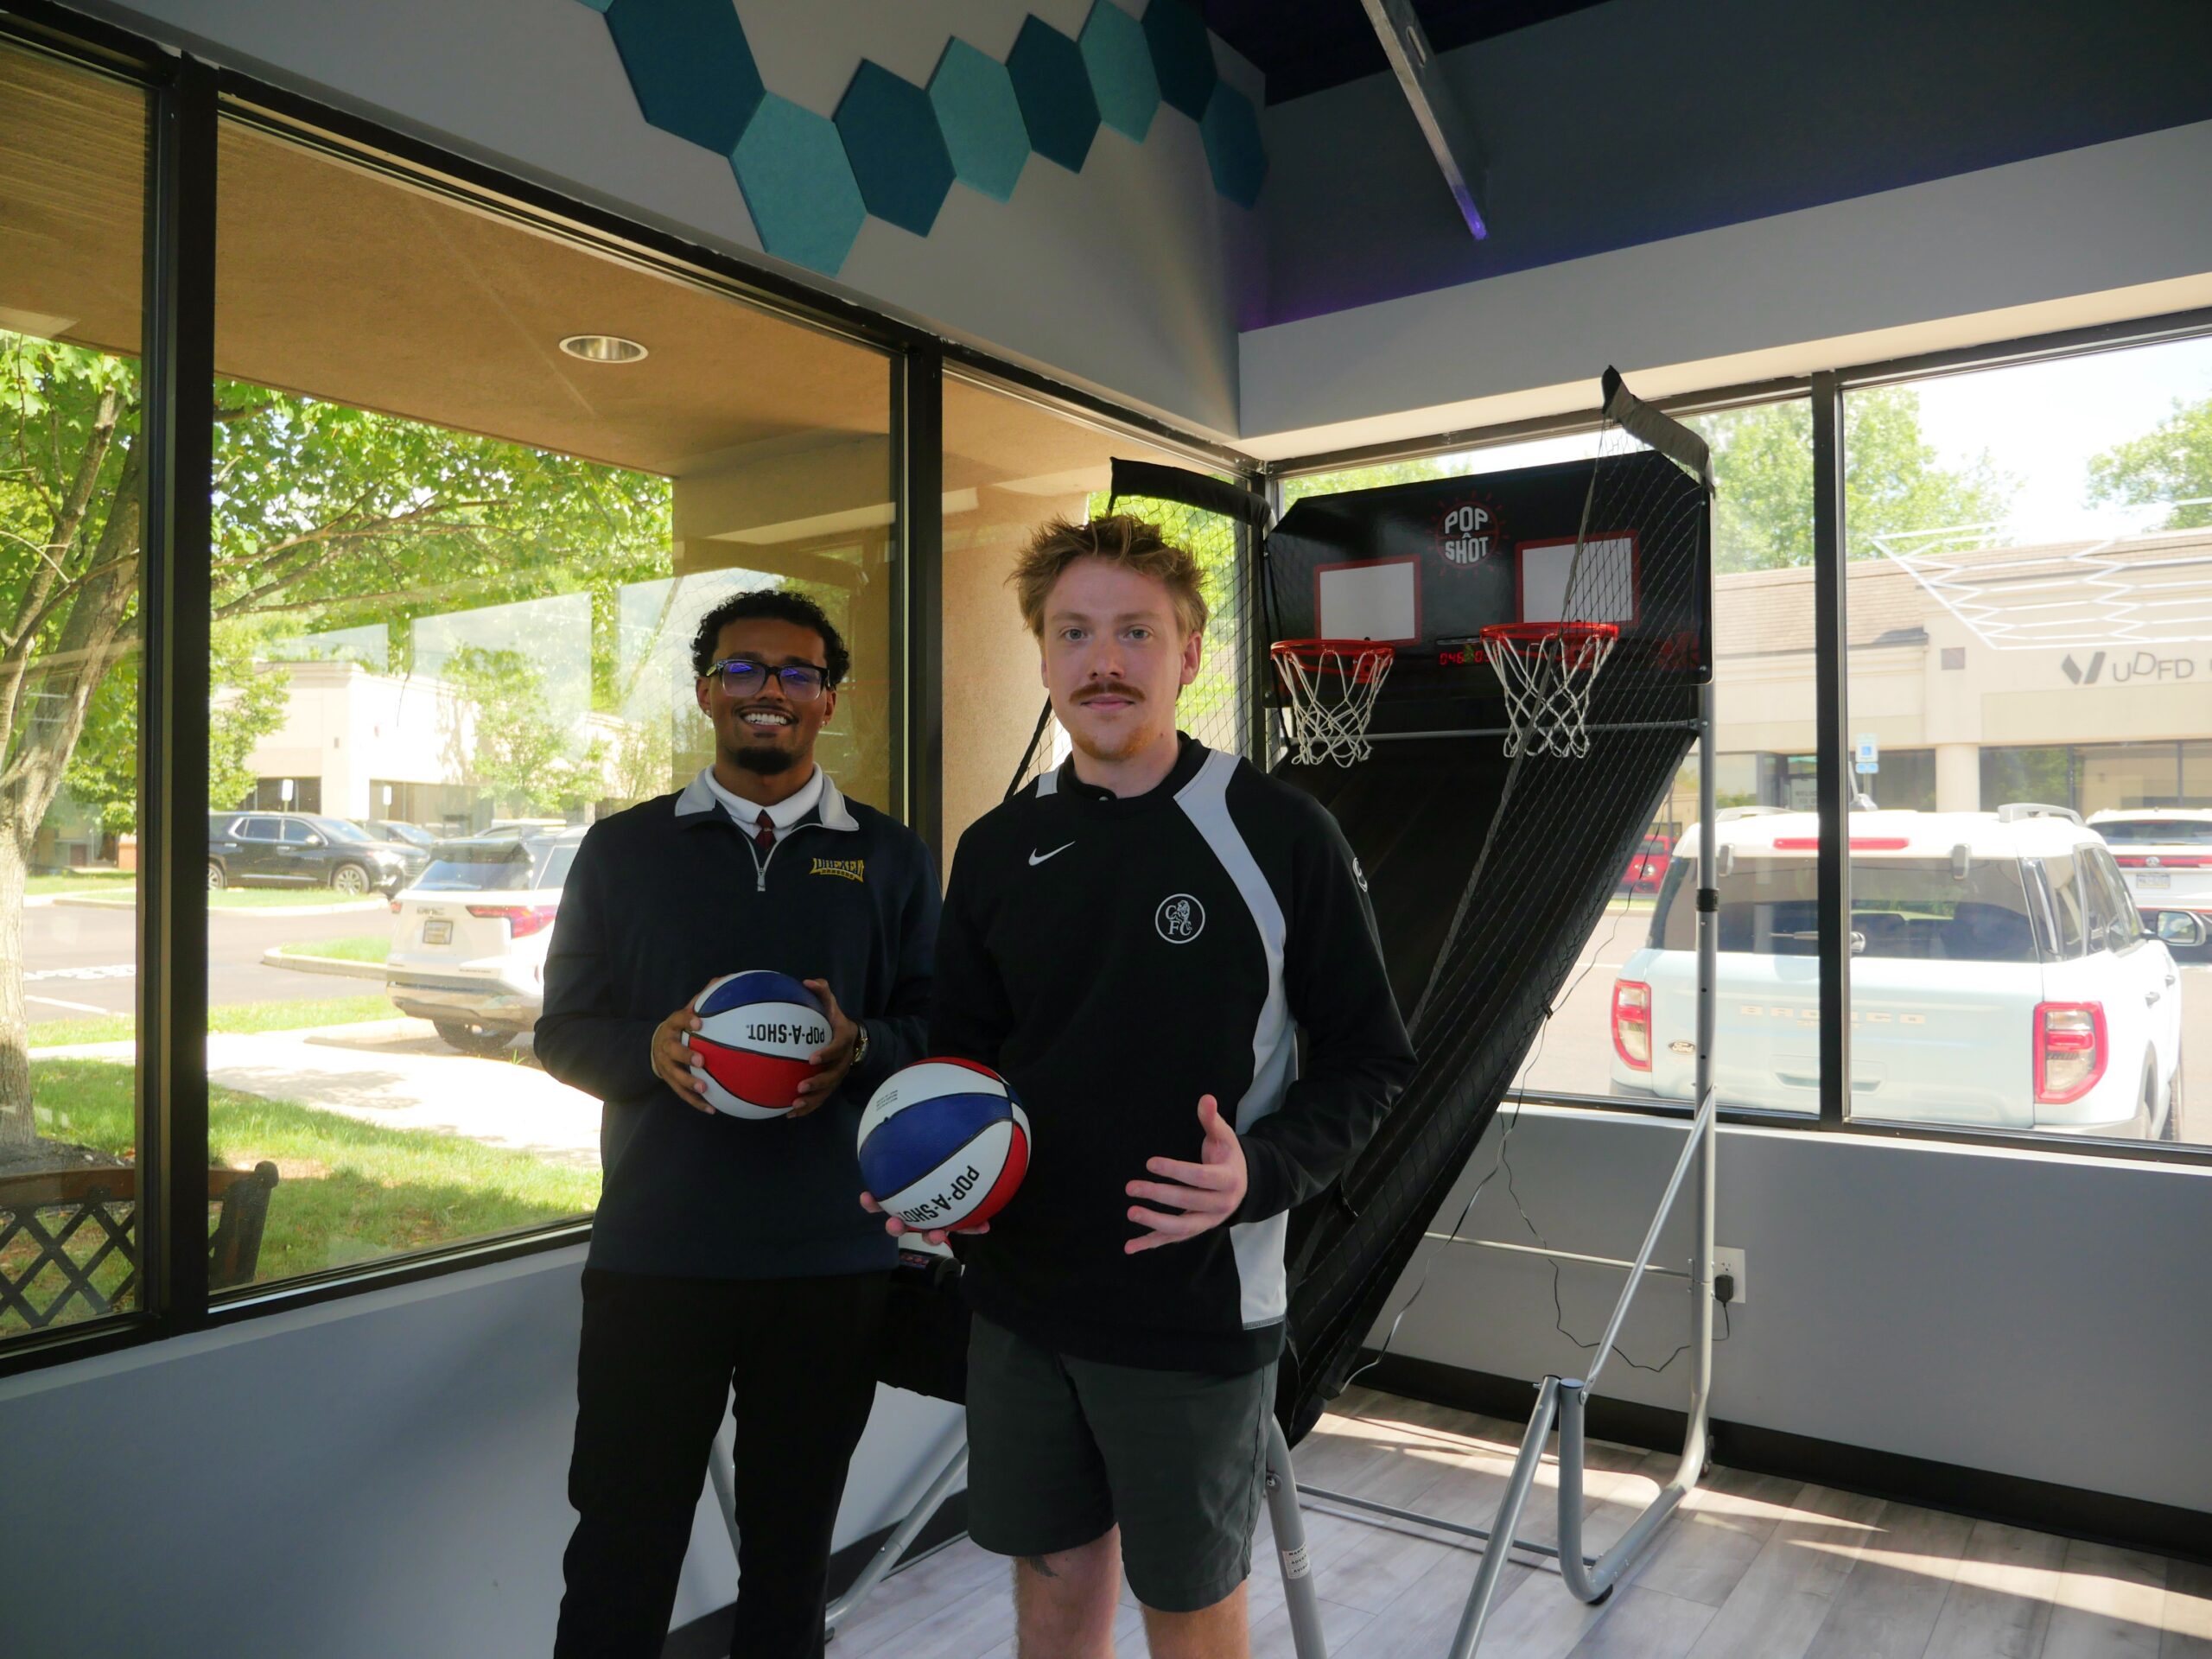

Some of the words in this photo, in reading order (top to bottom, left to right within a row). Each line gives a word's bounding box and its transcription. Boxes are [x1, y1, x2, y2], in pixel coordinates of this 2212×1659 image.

[1444, 506, 1488, 534] POP
[1445, 537, 1489, 563] SHOT
[1740, 1004, 1926, 1024] BROCO
[747, 1023, 825, 1045] POP-A-SHOT
